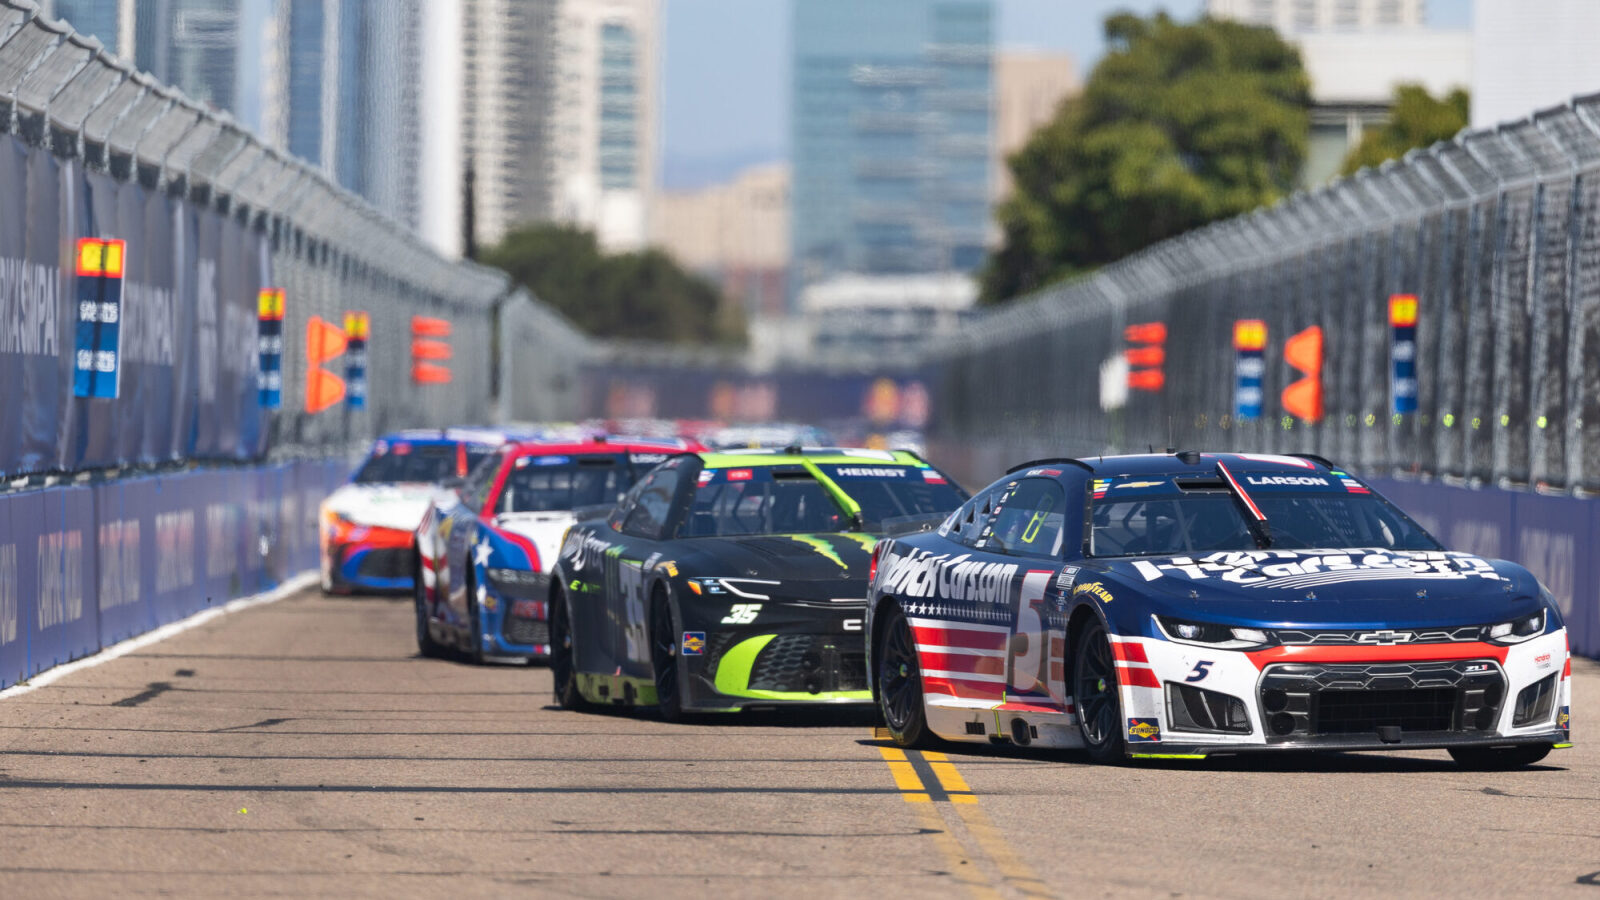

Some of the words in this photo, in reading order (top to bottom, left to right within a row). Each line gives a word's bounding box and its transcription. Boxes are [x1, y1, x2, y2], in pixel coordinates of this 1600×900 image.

[836, 467, 907, 478] HERBST
[1246, 476, 1330, 487] LARSON
[720, 603, 764, 625] 35
[1011, 569, 1055, 694] 5
[1184, 660, 1216, 683] 5
[1130, 727, 1159, 735] SUNOCO
